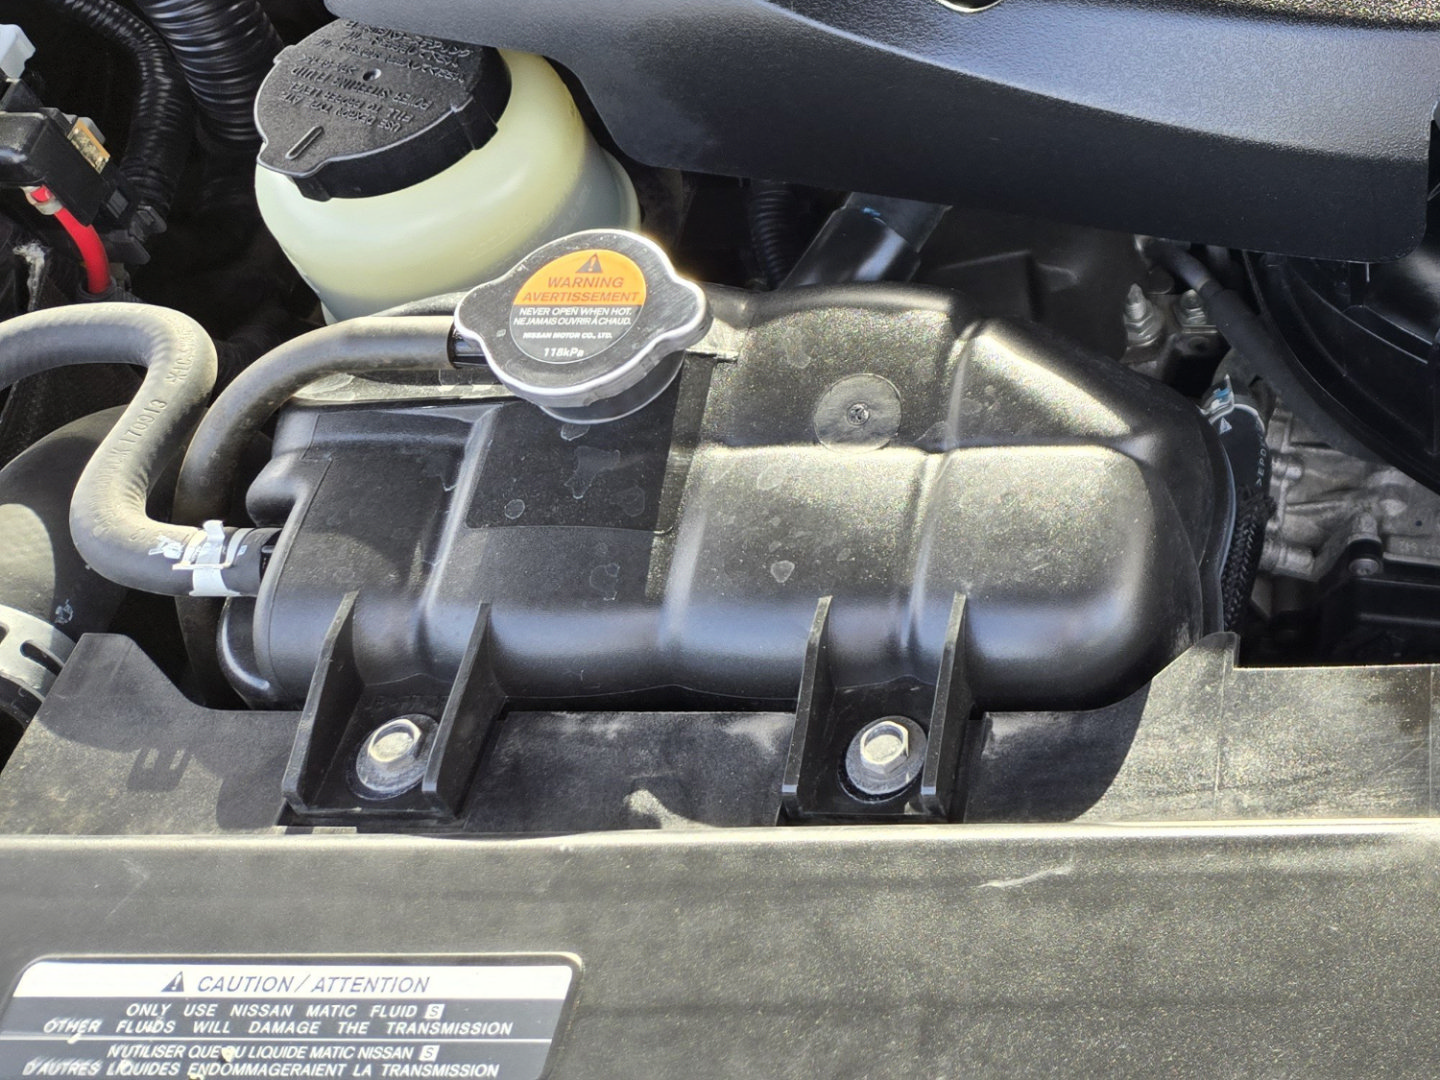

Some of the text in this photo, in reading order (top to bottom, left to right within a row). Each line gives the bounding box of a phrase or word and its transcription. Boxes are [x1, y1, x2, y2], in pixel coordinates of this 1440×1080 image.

[547, 276, 624, 288] WARNING
[522, 291, 639, 302] AVERTISSEMENT
[519, 307, 632, 316] NEVER OPEN WHEN HOT.
[557, 317, 590, 326] OUVRIR
[126, 1003, 171, 1017] ONLY
[183, 1003, 218, 1017] USE
[230, 1004, 293, 1018] NISSAN
[306, 1004, 357, 1018] MATIC
[370, 1005, 418, 1018] FLUID
[43, 1019, 513, 1035] OTHER FLUIDS WILL DAMAGE THE TRANSMISSION
[107, 1045, 186, 1058] N'UTILISER
[188, 1045, 222, 1059] QUE
[248, 1045, 308, 1059] LIQUIDE
[309, 1046, 356, 1059] MATIC
[357, 1046, 414, 1059] NISSAN
[106, 1062, 180, 1076] LIQUIDES
[187, 1062, 347, 1077] ENDOMMAGERAIENT
[352, 1064, 372, 1077] LA
[381, 1063, 500, 1077] TRANSMISSION
